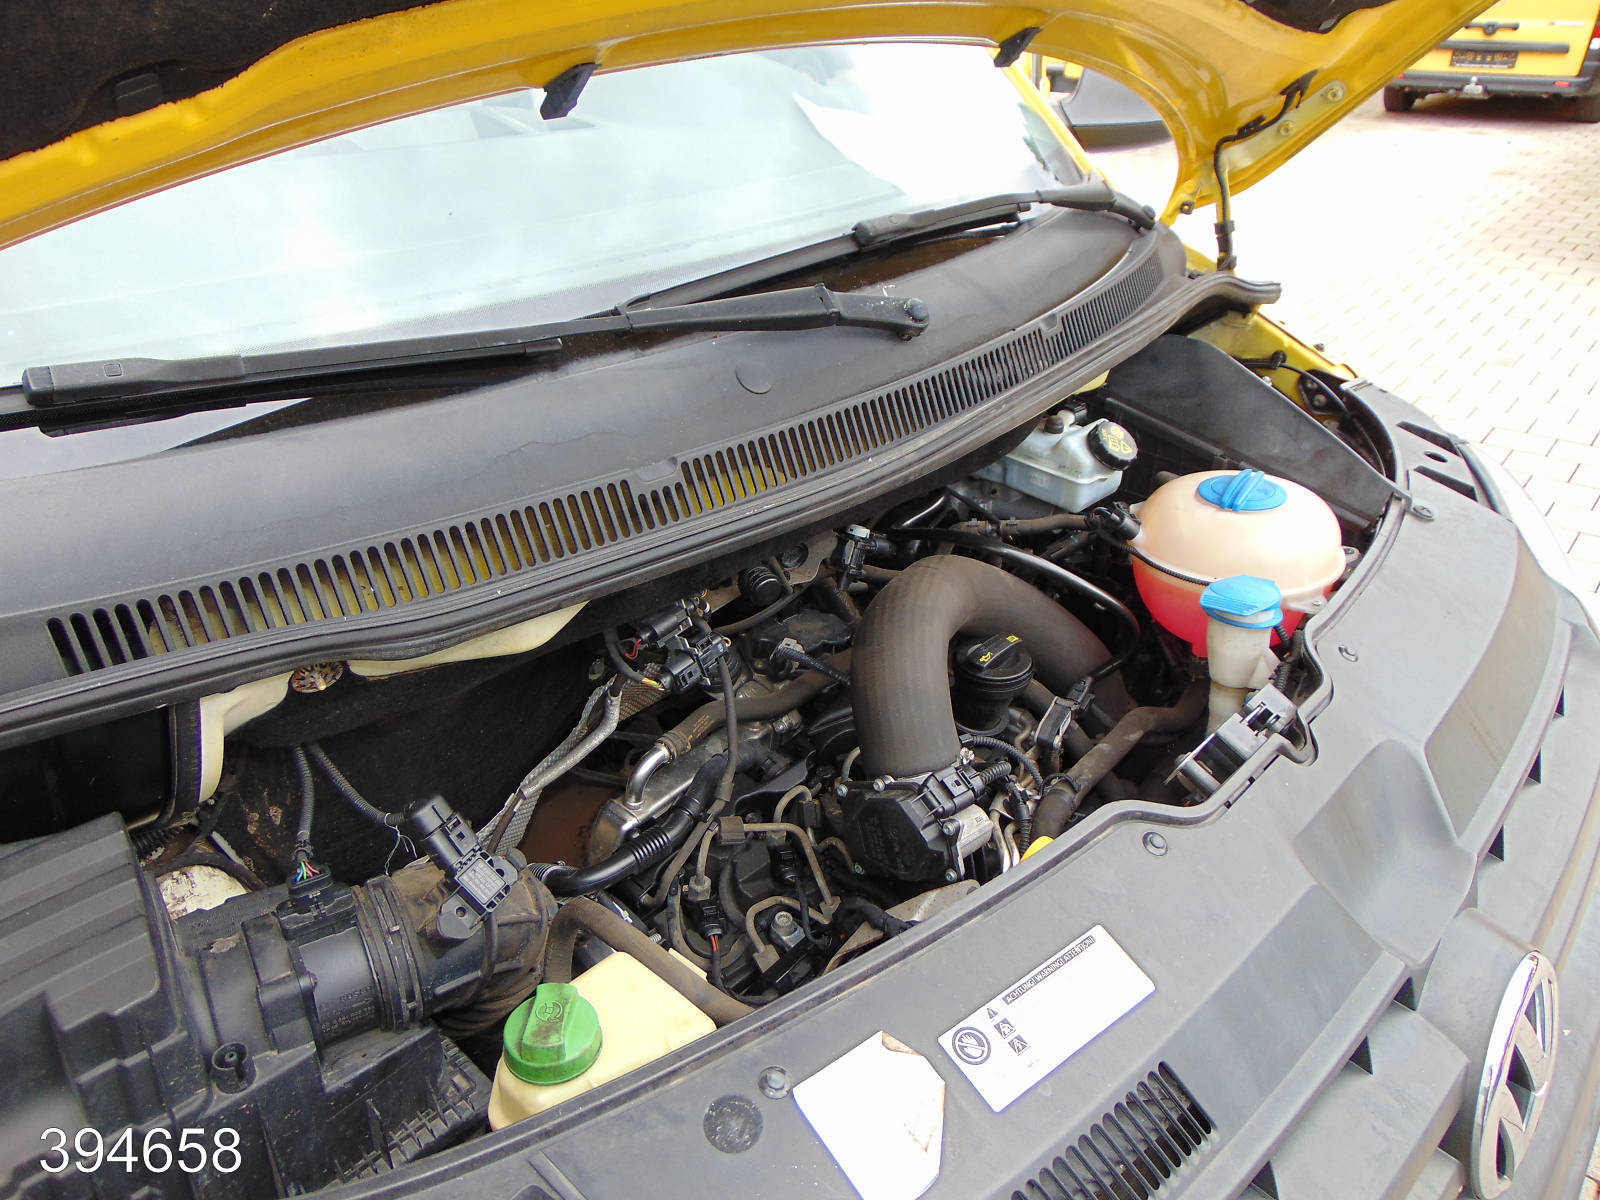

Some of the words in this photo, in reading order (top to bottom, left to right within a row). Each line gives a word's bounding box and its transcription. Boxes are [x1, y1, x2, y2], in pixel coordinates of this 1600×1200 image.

[1006, 976, 1037, 1003] ACHTUNG!
[1034, 956, 1064, 981] WARNING!
[1063, 936, 1095, 962] ATTENTION!
